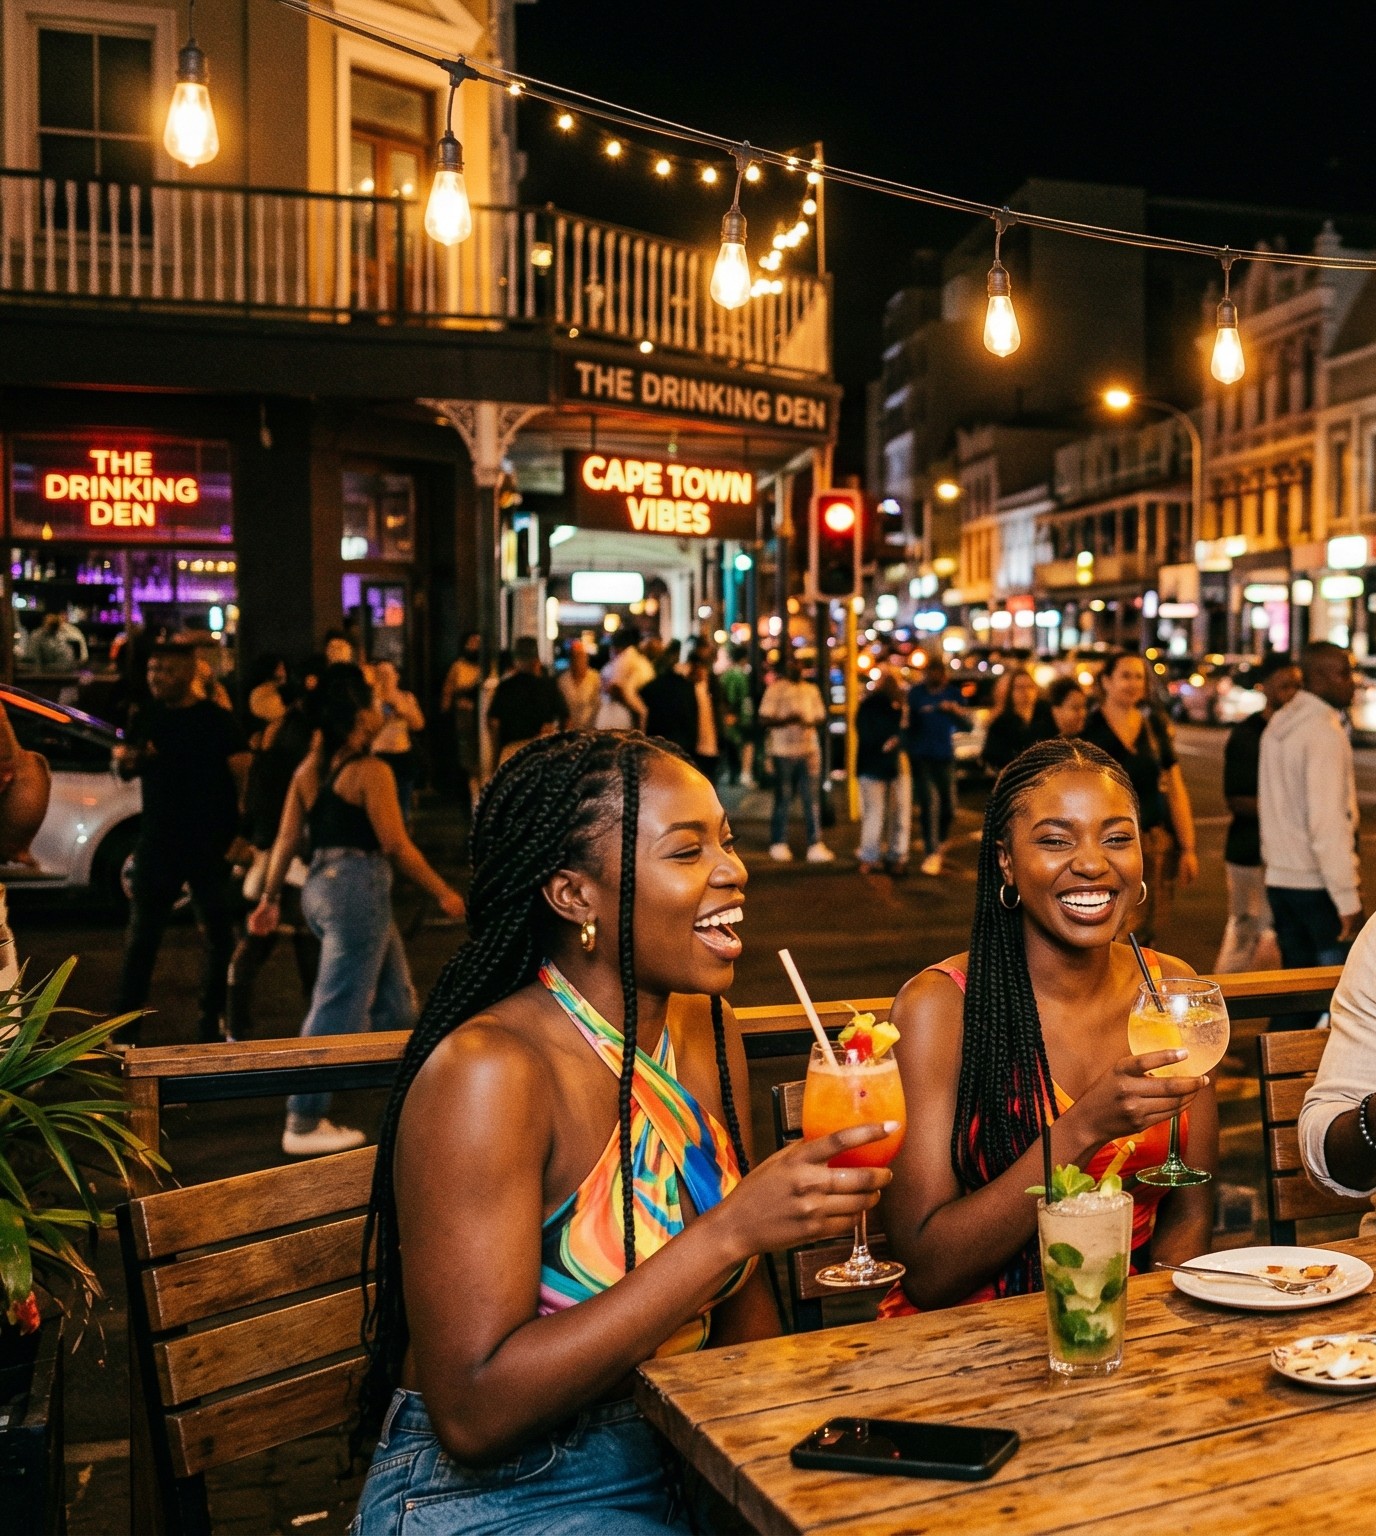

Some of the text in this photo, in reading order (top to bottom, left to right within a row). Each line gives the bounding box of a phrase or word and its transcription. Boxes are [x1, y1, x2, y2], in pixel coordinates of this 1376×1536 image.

[575, 361, 826, 429] THE DRINKING DEN
[89, 449, 153, 476] THE
[582, 455, 752, 504] CAPE TOWN
[45, 474, 198, 503] DRINKING
[89, 501, 155, 527] DEN
[626, 496, 711, 535] VIBES
